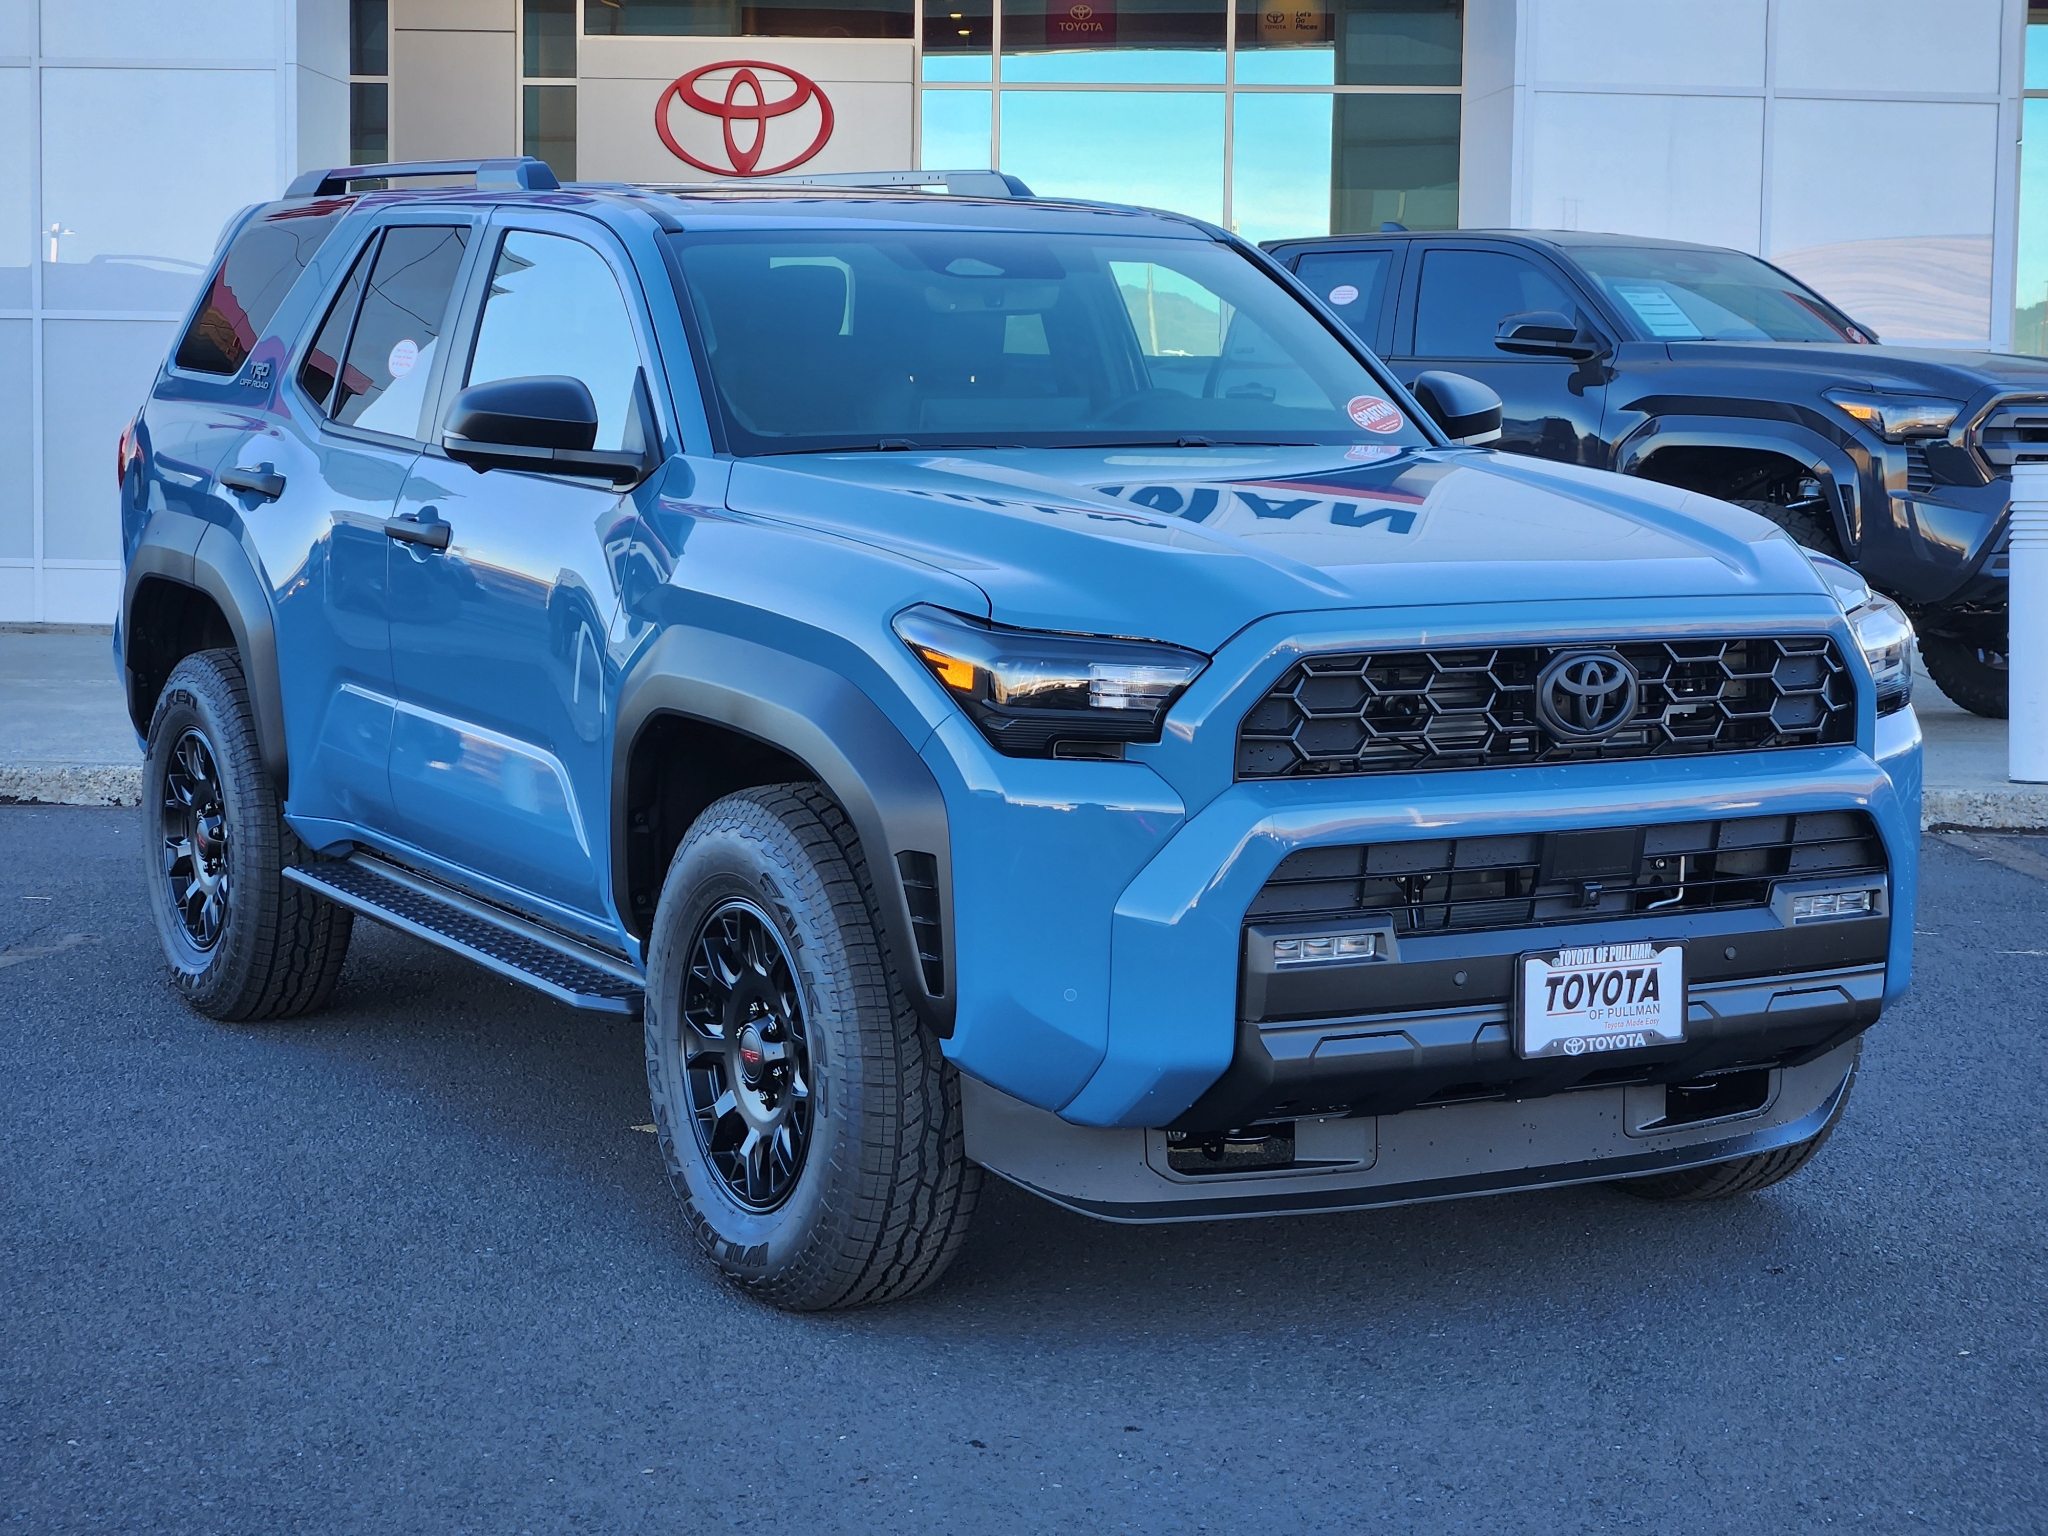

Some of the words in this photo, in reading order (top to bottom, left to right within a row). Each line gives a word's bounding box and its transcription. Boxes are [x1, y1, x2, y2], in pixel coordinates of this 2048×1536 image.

[1059, 22, 1103, 31] TOYOTA
[250, 361, 270, 380] TRD
[239, 378, 252, 387] OFF
[252, 379, 269, 389] ROAD
[1353, 402, 1396, 426] SPARTAN
[1558, 947, 1594, 967] TOYOTA
[1595, 946, 1609, 963] OF
[1609, 942, 1652, 962] PULLMAN
[1545, 967, 1660, 1012] TOYOTA
[1589, 1008, 1604, 1020] OF
[1607, 1003, 1660, 1019] PULLMAN
[1604, 1020, 1625, 1030] Toyota
[1626, 1018, 1644, 1028] Made
[1645, 1017, 1660, 1026] Easy
[1587, 1032, 1646, 1052] TOYOTA
[741, 1047, 760, 1063] TRD
